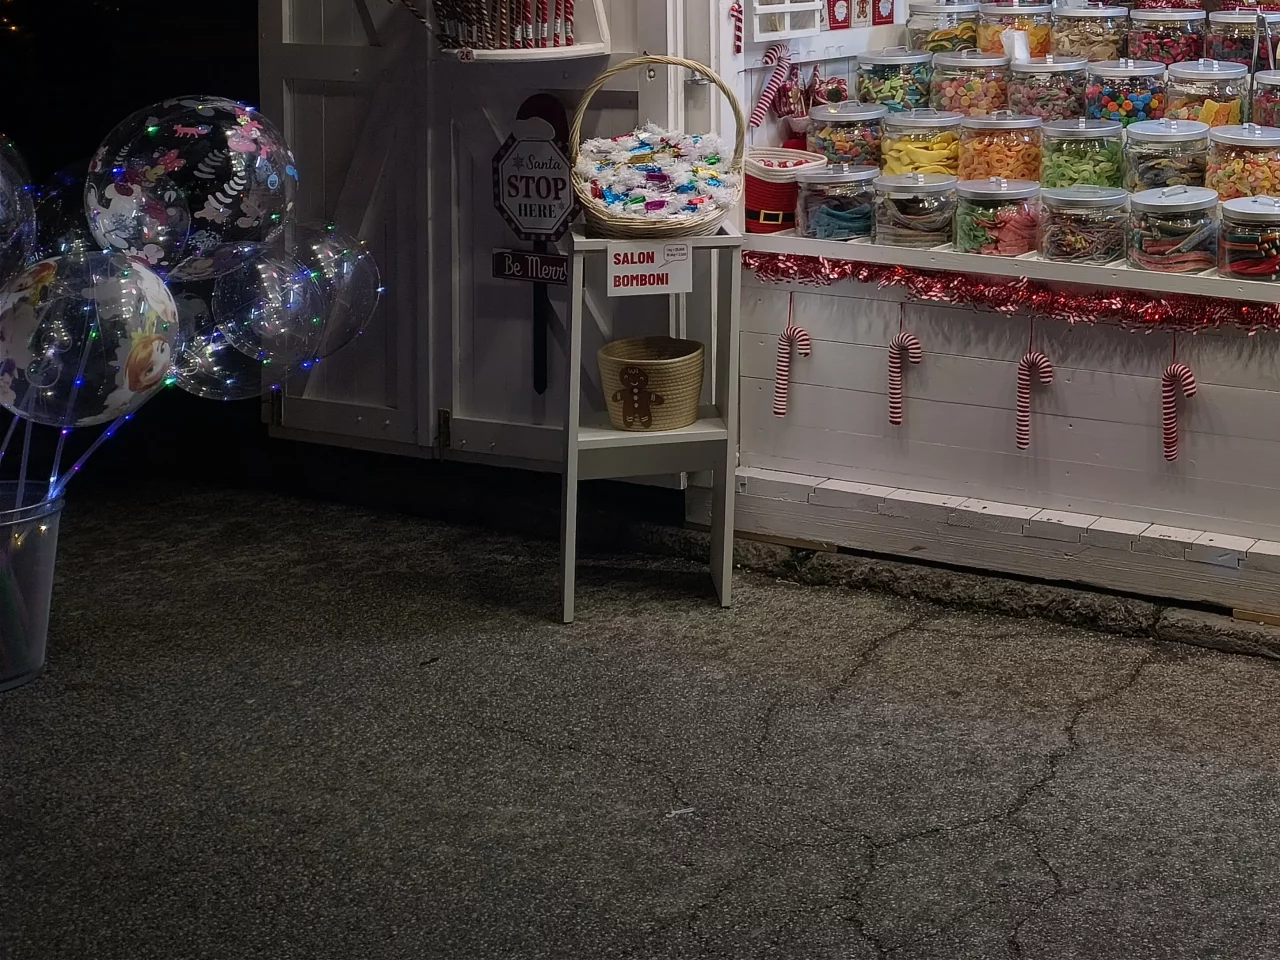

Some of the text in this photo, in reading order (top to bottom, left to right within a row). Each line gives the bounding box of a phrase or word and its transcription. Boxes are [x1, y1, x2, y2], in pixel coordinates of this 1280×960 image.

[526, 154, 562, 170] Santa
[507, 174, 567, 201] STOP
[518, 203, 557, 218] HERE
[503, 253, 523, 276] Be
[613, 251, 655, 265] SALON
[613, 272, 669, 288] BOMBONI
